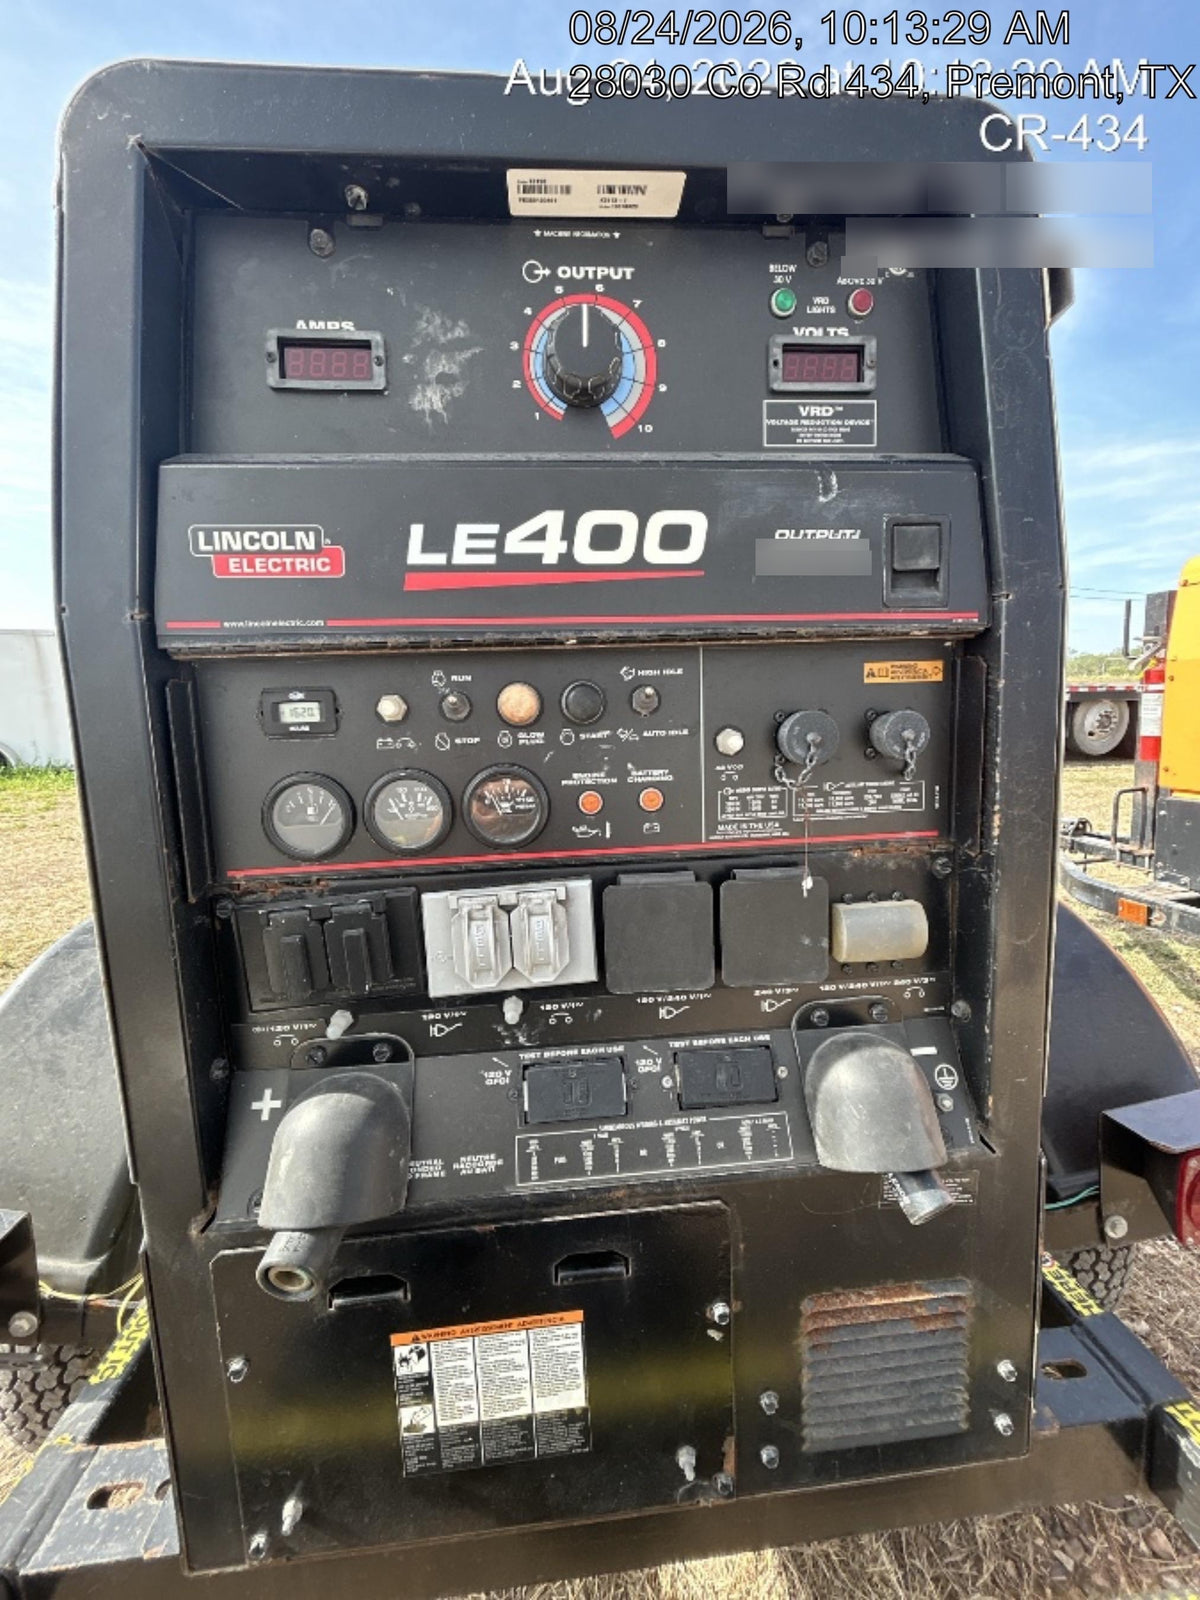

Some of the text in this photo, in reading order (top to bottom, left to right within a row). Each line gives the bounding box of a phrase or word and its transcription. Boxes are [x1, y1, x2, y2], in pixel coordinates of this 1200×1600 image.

[557, 266, 636, 280] OUTPUT
[769, 264, 797, 273] BELOW
[554, 286, 564, 294] 5
[595, 284, 605, 292] 6
[632, 299, 643, 308] 7
[523, 307, 533, 315] 4
[806, 305, 836, 314] LIGHTS
[510, 341, 519, 350] 3
[512, 380, 522, 388] 2
[534, 412, 540, 420] 1
[638, 424, 653, 432] 10
[197, 530, 316, 551] LINCOLN
[228, 557, 332, 574] ELECTRIC
[223, 619, 325, 628] www.lincolnelectric.com
[692, 1037, 726, 1046] BEFORE
[728, 1034, 751, 1043] EACH
[753, 1033, 770, 1041] USE
[543, 1050, 579, 1058] BEFORE
[580, 1047, 605, 1055] EACH
[607, 1045, 625, 1053] USE
